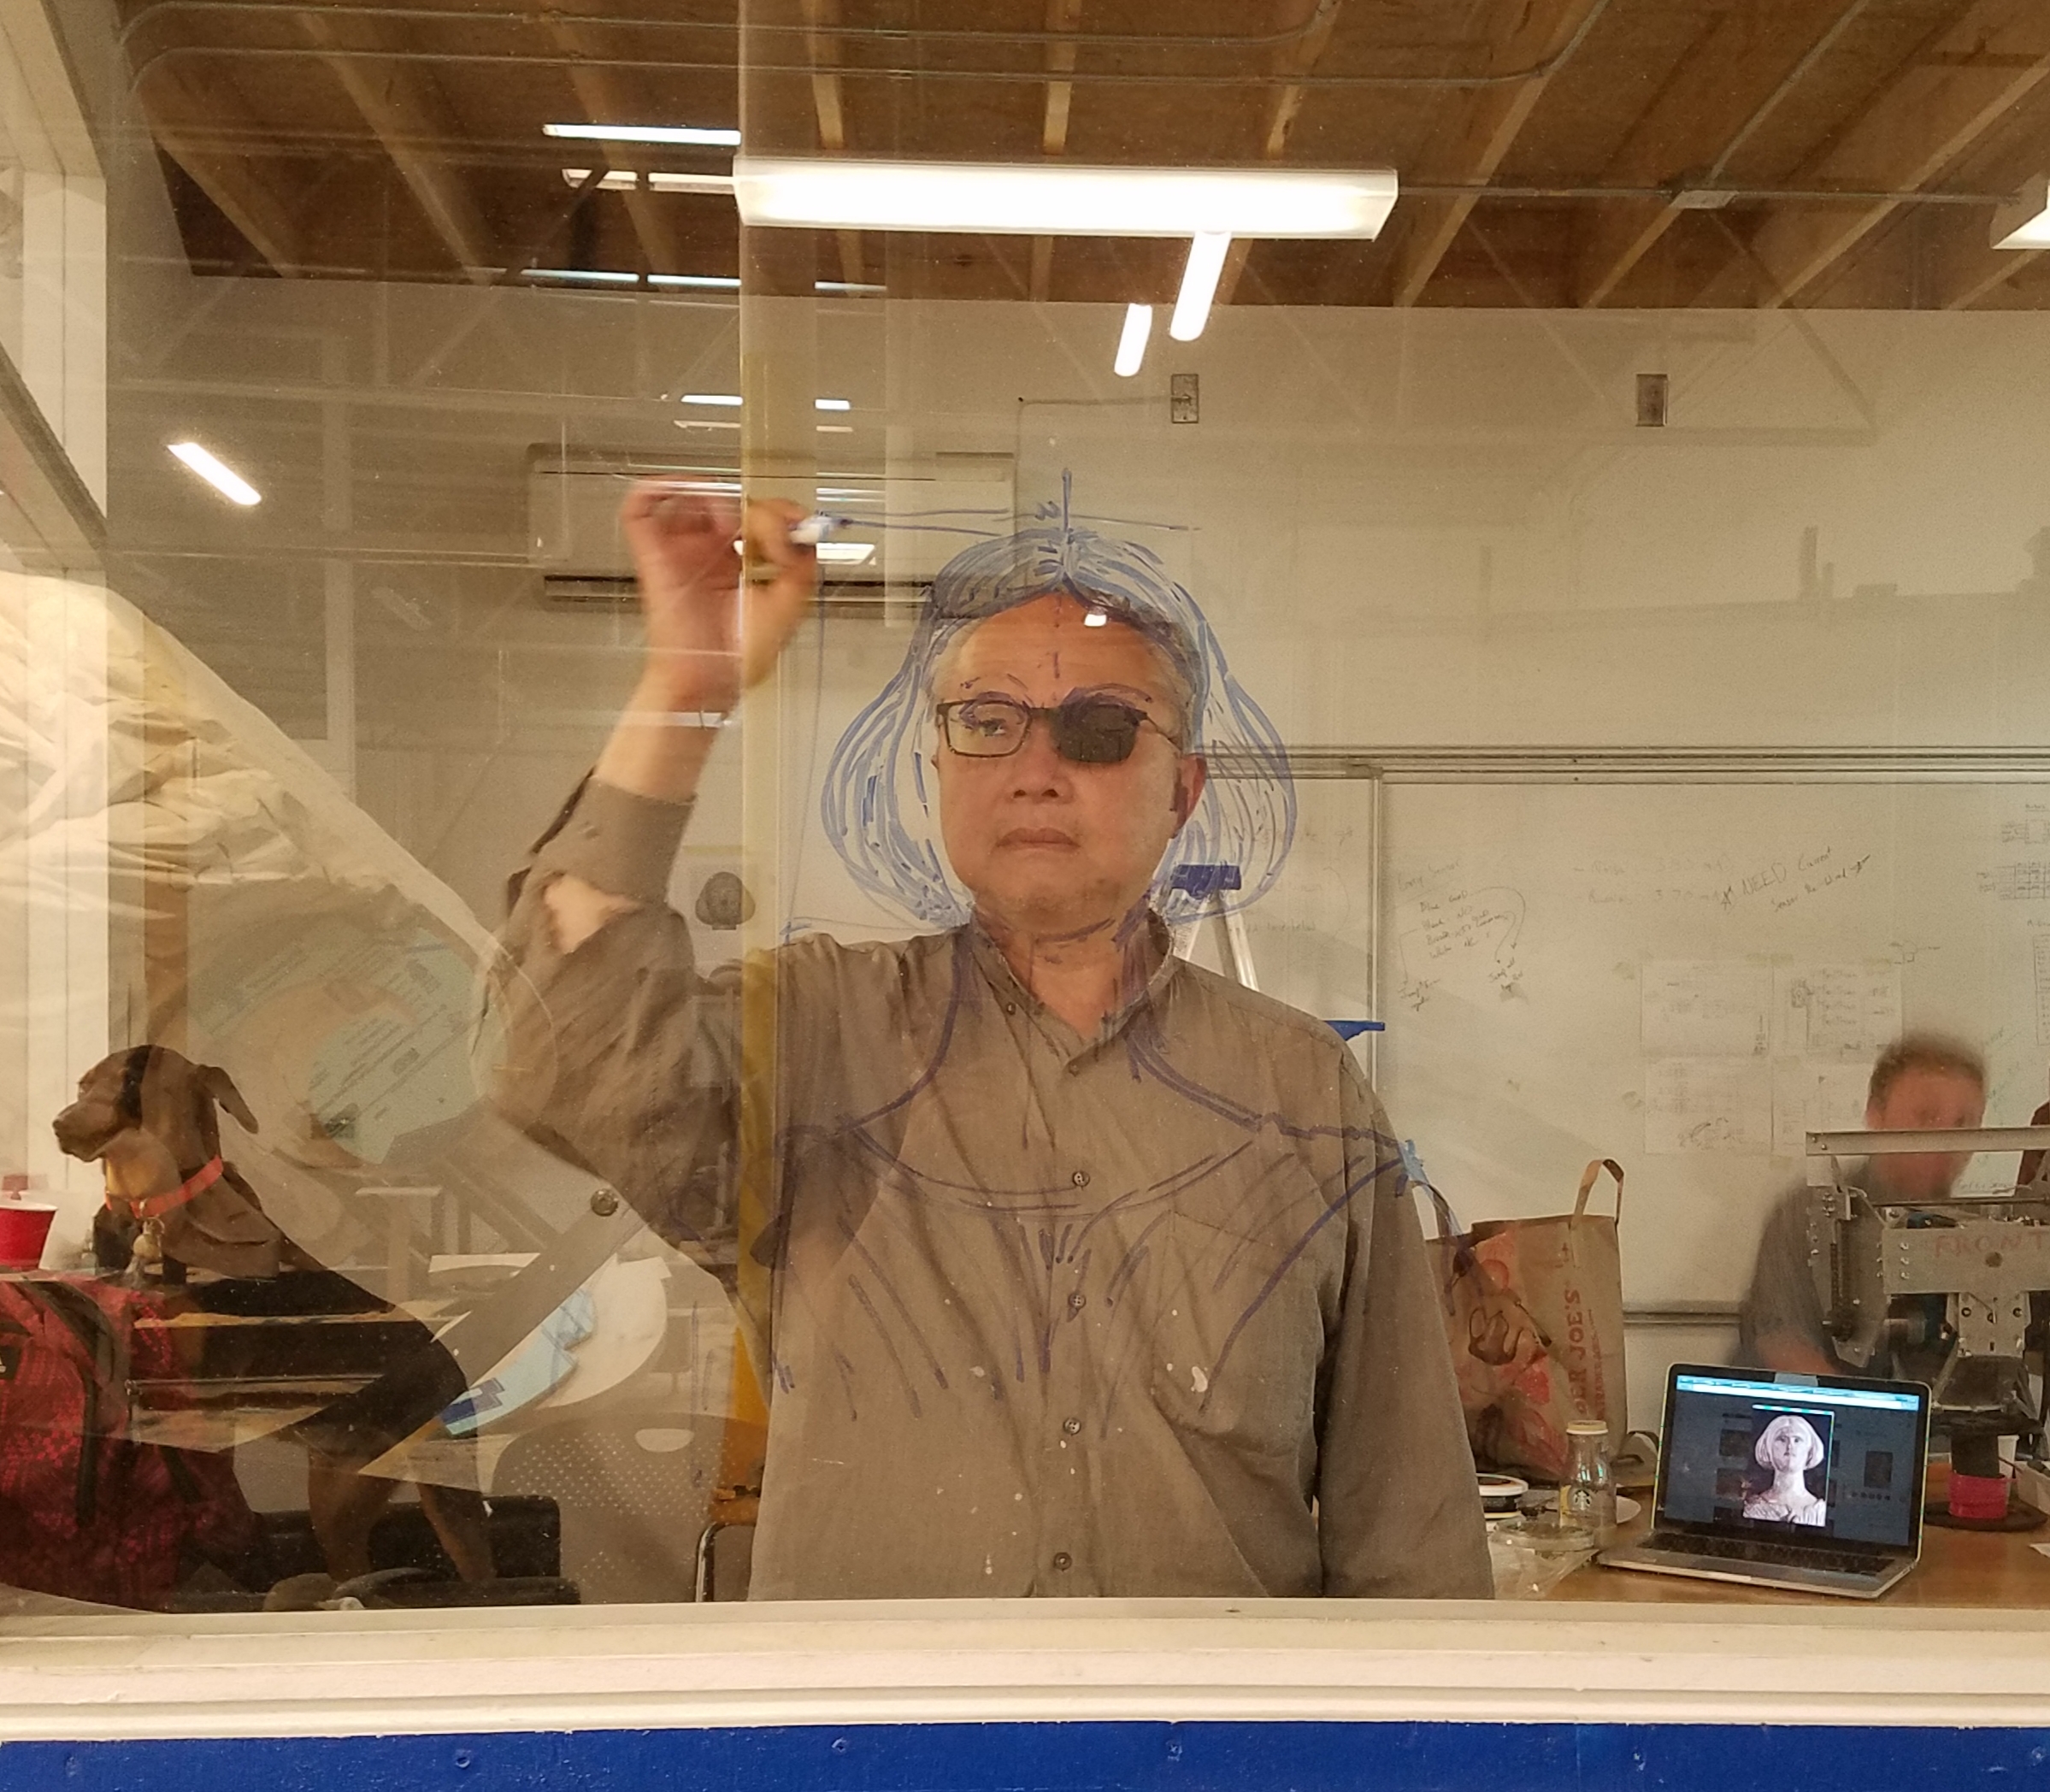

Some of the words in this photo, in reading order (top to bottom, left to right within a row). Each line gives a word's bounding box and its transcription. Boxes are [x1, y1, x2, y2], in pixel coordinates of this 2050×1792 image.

[1741, 862, 1787, 896] NEED
[1935, 1229, 2050, 1259] FRONT
[1564, 1288, 1587, 1360] JOE'S
[1568, 1369, 1588, 1416] DER
